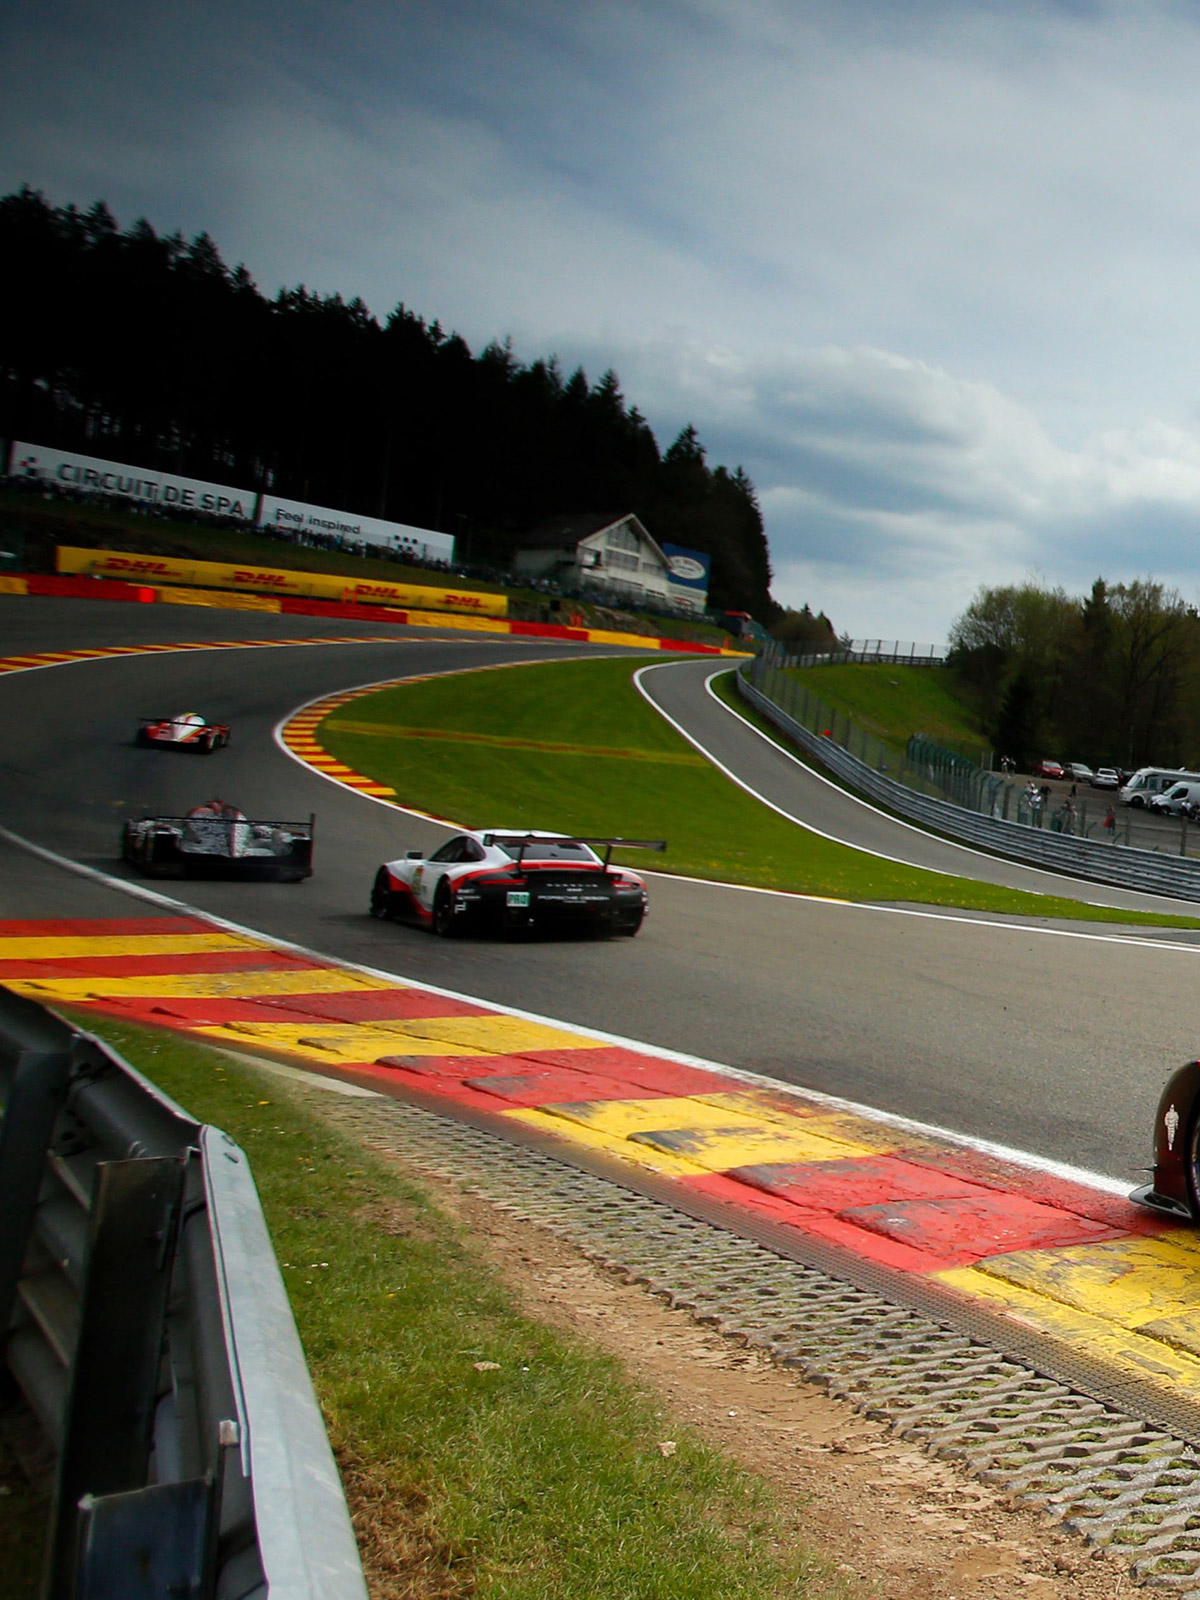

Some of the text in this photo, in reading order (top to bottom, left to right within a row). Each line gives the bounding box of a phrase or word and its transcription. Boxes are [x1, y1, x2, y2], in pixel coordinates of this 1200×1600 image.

[57, 463, 244, 517] CIRCUIT DE SPA
[276, 508, 360, 534] Feel inspired
[107, 557, 171, 576] DHL
[234, 571, 289, 588] DHL
[356, 585, 403, 599] DHL
[444, 595, 484, 608] DHL
